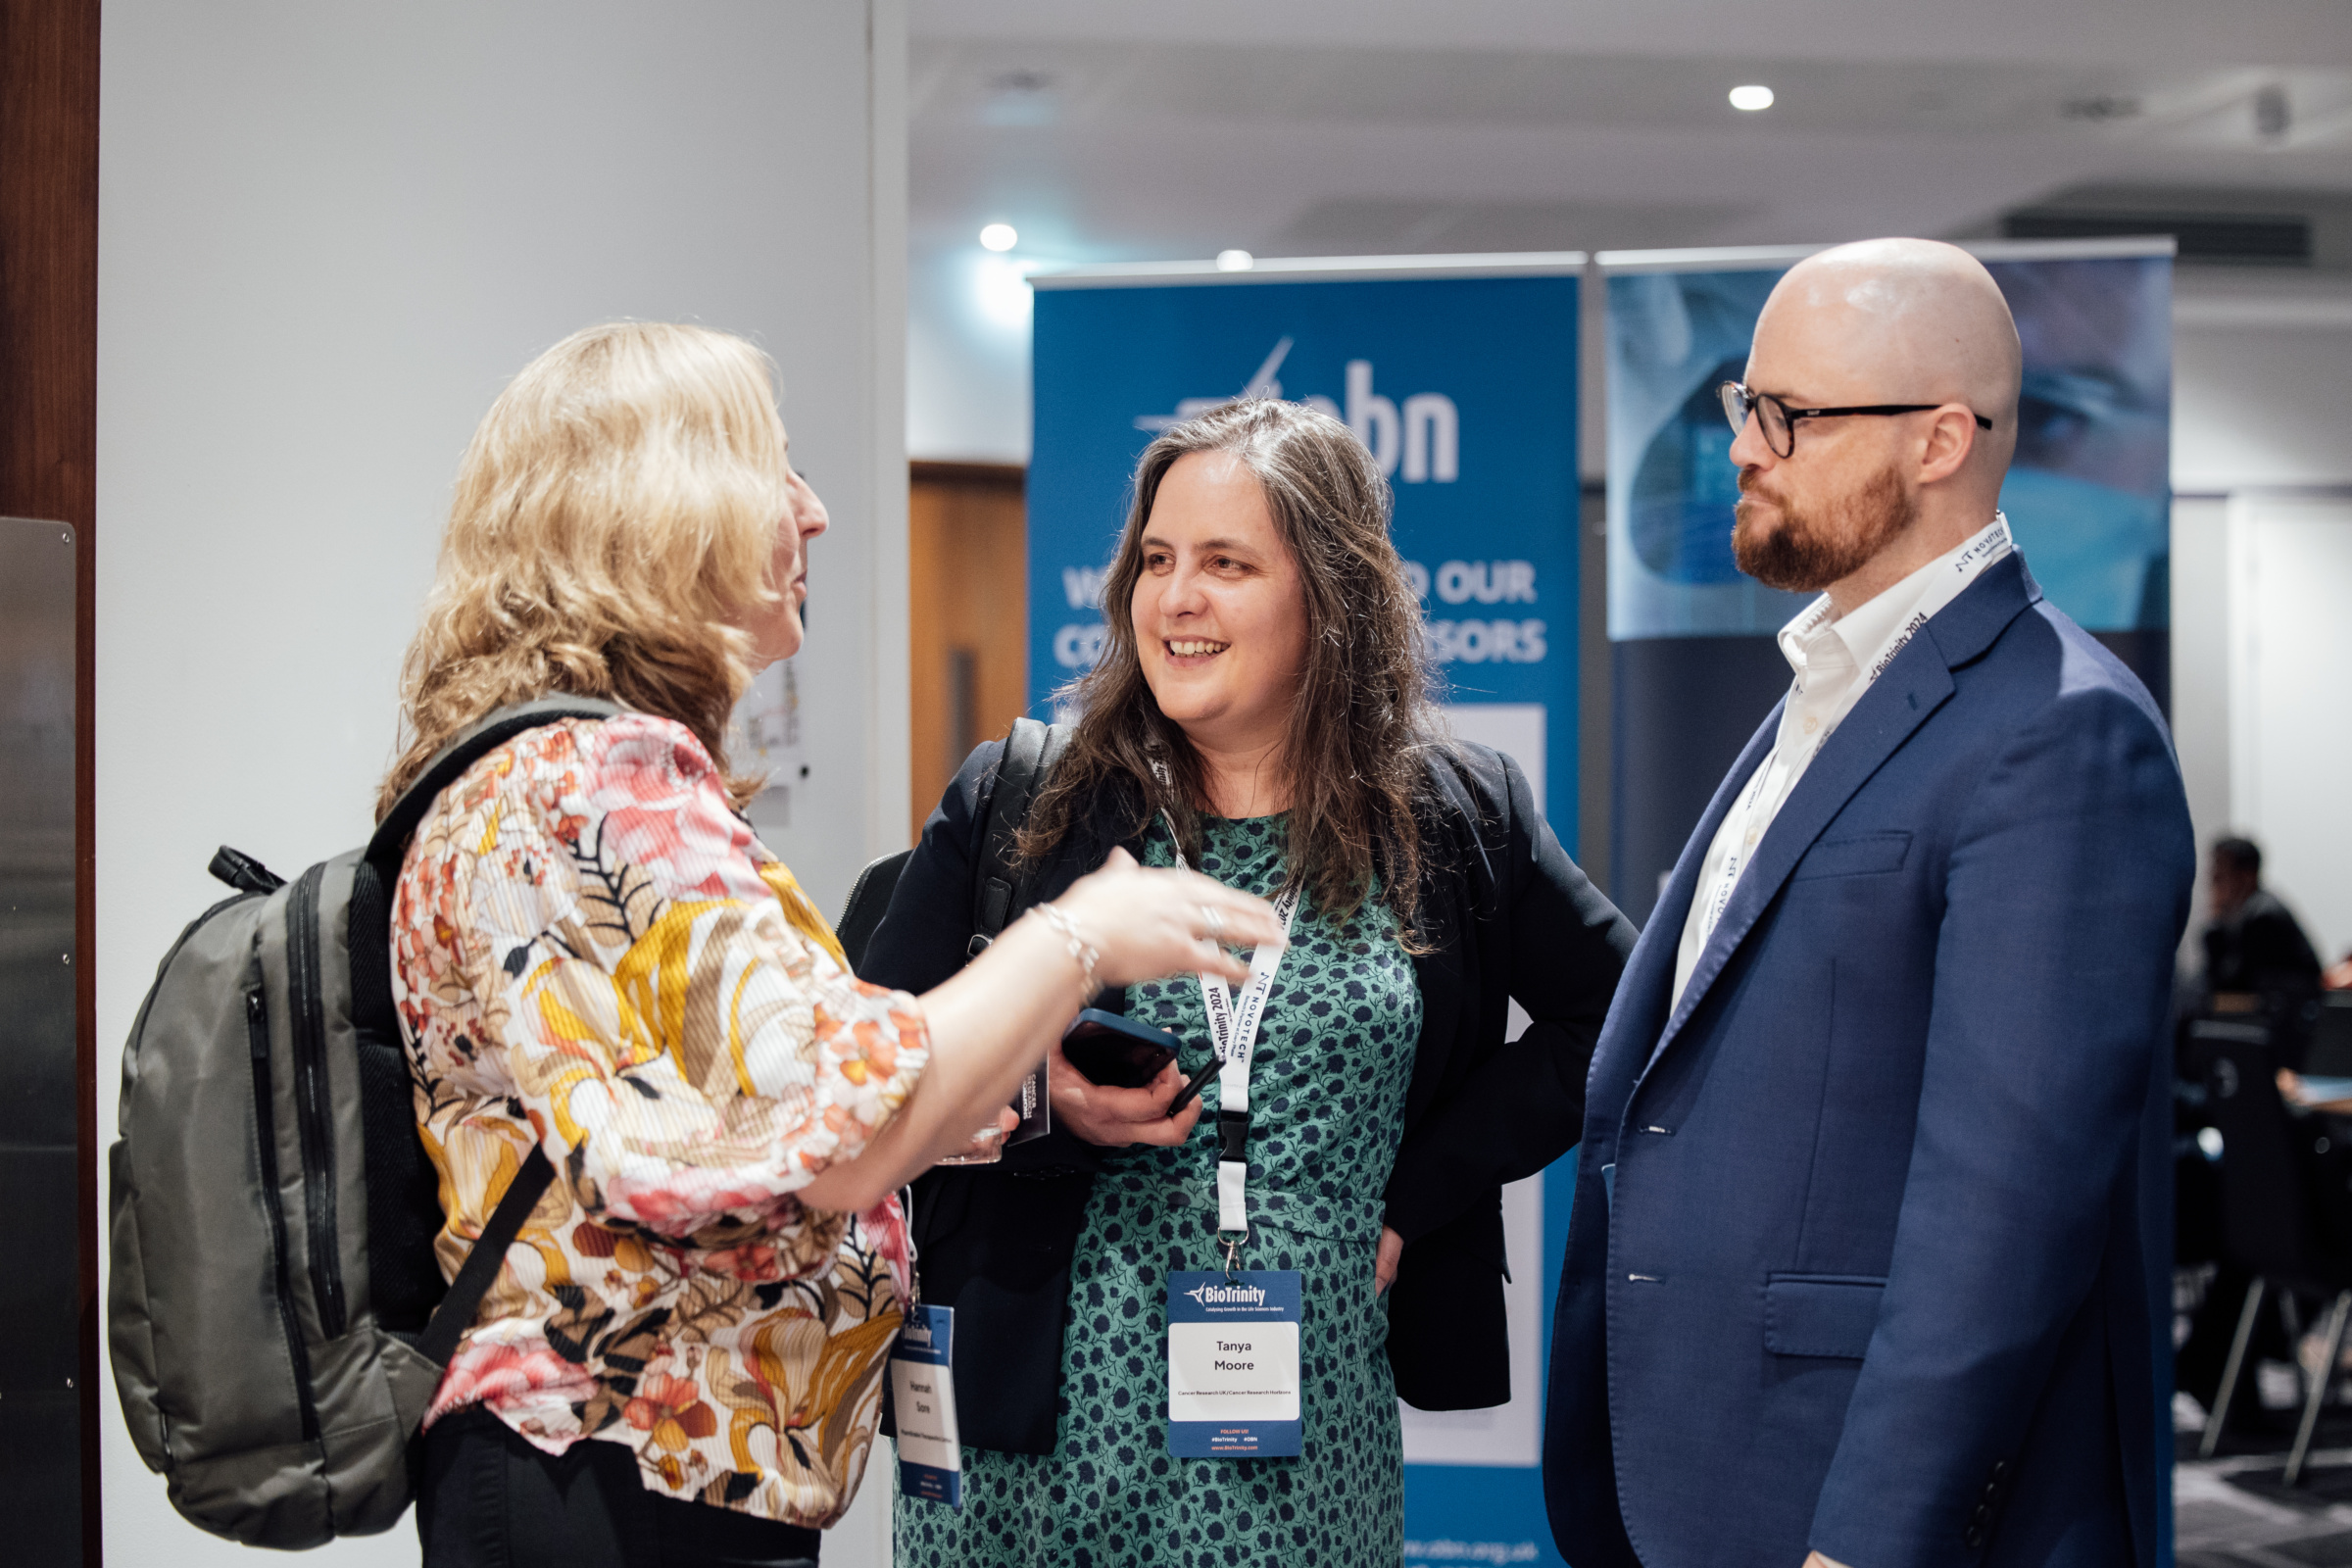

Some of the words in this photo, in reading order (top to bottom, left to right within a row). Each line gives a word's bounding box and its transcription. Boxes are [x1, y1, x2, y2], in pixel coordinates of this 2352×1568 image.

[1299, 359, 1459, 484] bn
[1435, 560, 1538, 605] OUR
[1904, 612, 1928, 638] 2024
[1207, 987, 1223, 1011] 2024
[1205, 1285, 1265, 1306] BioTrinity
[1216, 1341, 1251, 1353] Tanya
[1214, 1360, 1254, 1370] Moore
